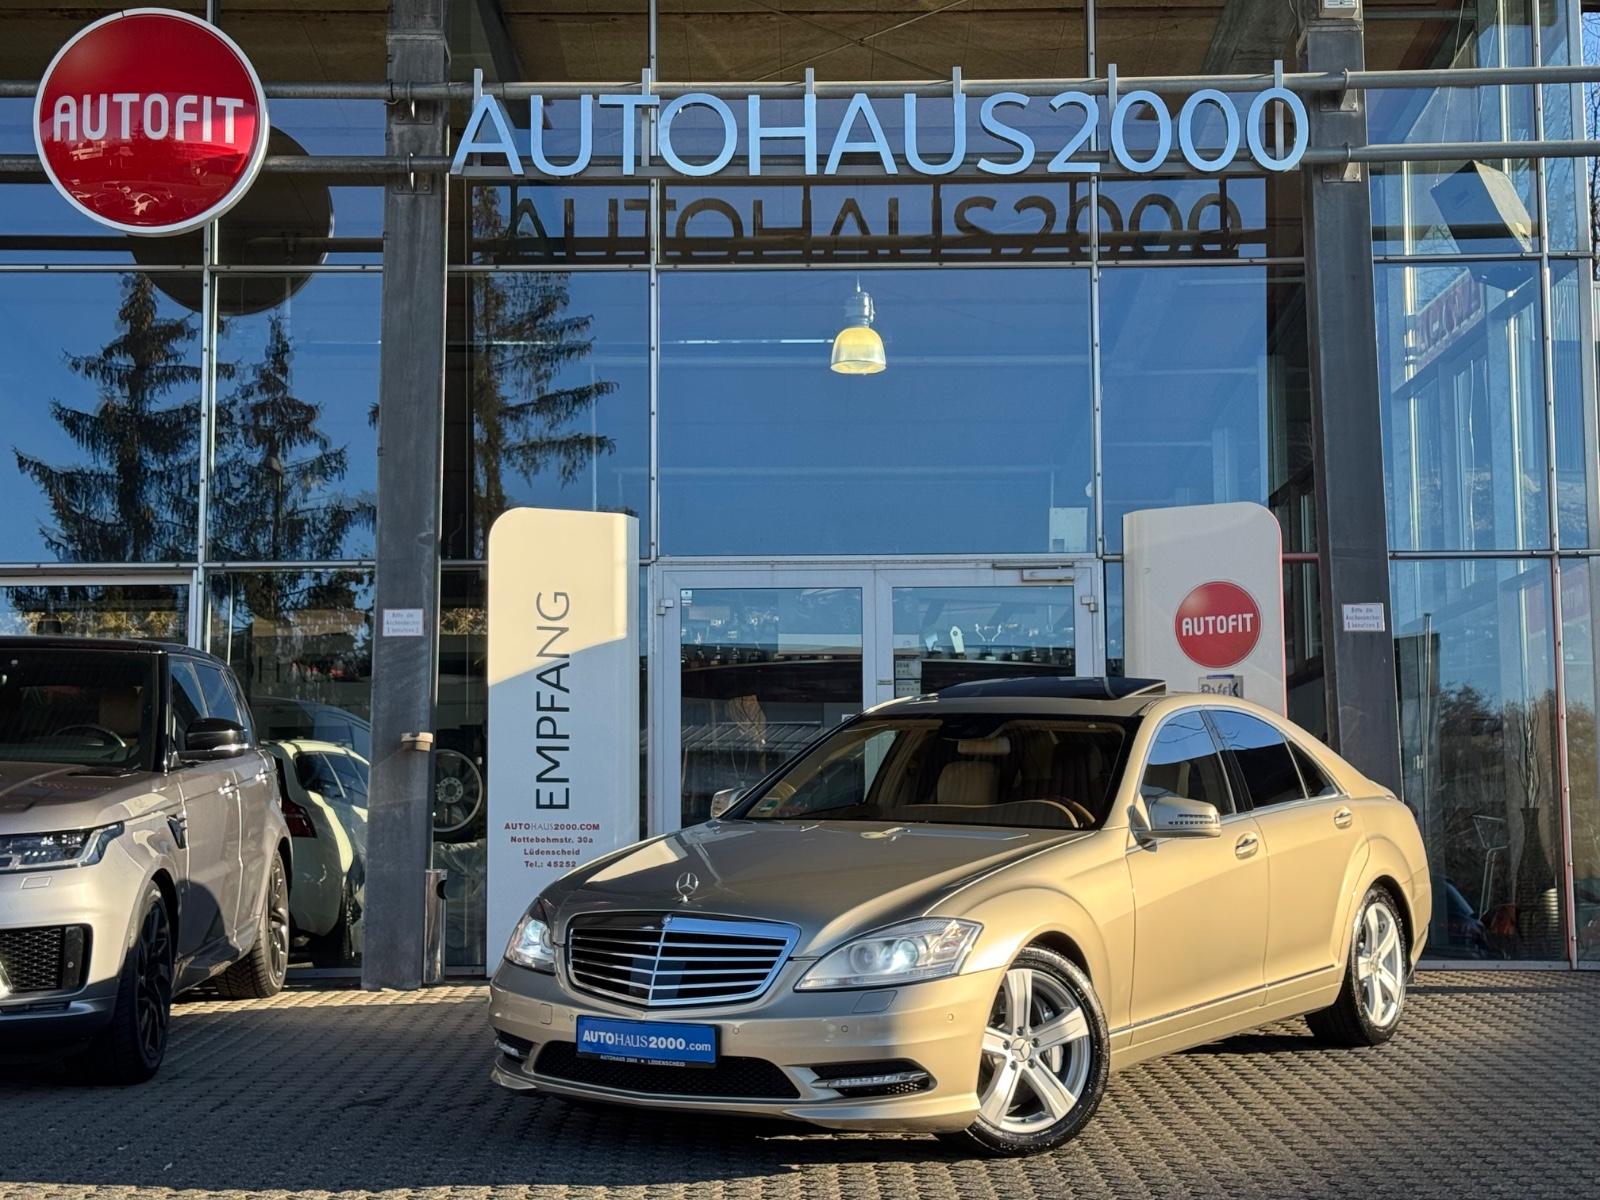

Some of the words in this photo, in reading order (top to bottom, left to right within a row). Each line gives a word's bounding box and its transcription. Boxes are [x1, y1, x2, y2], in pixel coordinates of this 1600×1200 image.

[53, 93, 244, 144] AUTOFIT
[449, 87, 1310, 177] AUTOHAUS2000
[1181, 612, 1255, 637] AUTOFIT
[535, 591, 570, 810] EMPFANG
[504, 822, 600, 831] AUTOHAUS2000.COM
[510, 835, 574, 844] Nottebohmstr.
[577, 836, 594, 844] 30a
[523, 848, 581, 856] Lüdenscheid
[524, 860, 544, 868] Tel.:
[547, 860, 577, 868] 45252
[582, 1029, 712, 1052] AUTOHAUS2000.com
